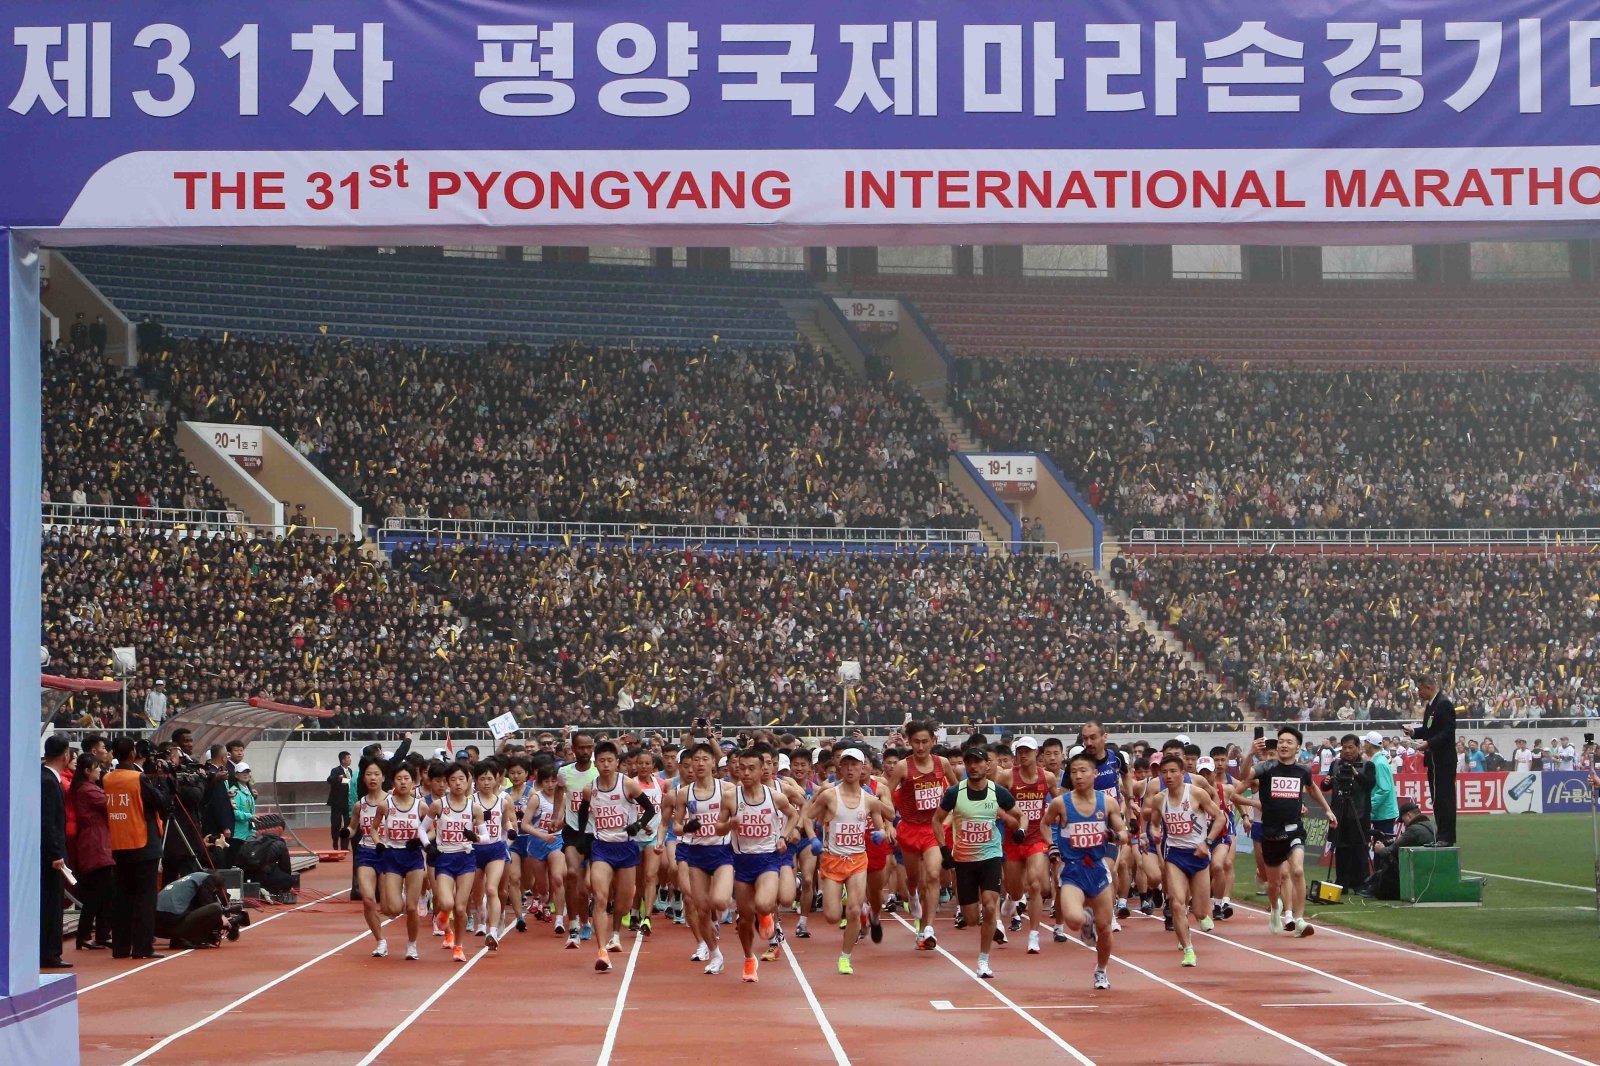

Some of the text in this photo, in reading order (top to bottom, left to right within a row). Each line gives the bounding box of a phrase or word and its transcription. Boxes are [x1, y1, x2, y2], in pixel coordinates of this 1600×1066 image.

[8, 22, 394, 118] 제31차
[173, 157, 1600, 211] THE 31st PYONGYANG INTERNATIONAL MARATHO
[851, 302, 875, 317] 19-2
[214, 432, 241, 449] 20-1
[987, 460, 1011, 475] 19-1
[914, 781, 941, 790] CHINA
[1272, 779, 1299, 789] 5027
[919, 788, 939, 799] PRK
[1016, 792, 1044, 800] CHINA
[917, 798, 941, 811] 1087
[1018, 800, 1039, 810] PRK
[109, 812, 128, 820] PHOTO
[596, 806, 618, 817] PRK
[596, 815, 623, 829] 1000
[696, 812, 718, 824] PRK
[742, 814, 766, 824] PRK
[1164, 812, 1185, 823] PRK
[392, 820, 413, 829] PRK
[446, 821, 468, 831] PRK
[840, 823, 862, 834] PRK
[966, 822, 989, 832] PRK
[1074, 822, 1100, 834] PRK
[389, 829, 417, 840] 1217
[442, 831, 468, 842] 120
[739, 825, 770, 837] 1009
[836, 834, 864, 846] 1056
[962, 831, 991, 843] 1081
[1071, 833, 1103, 848] 1012
